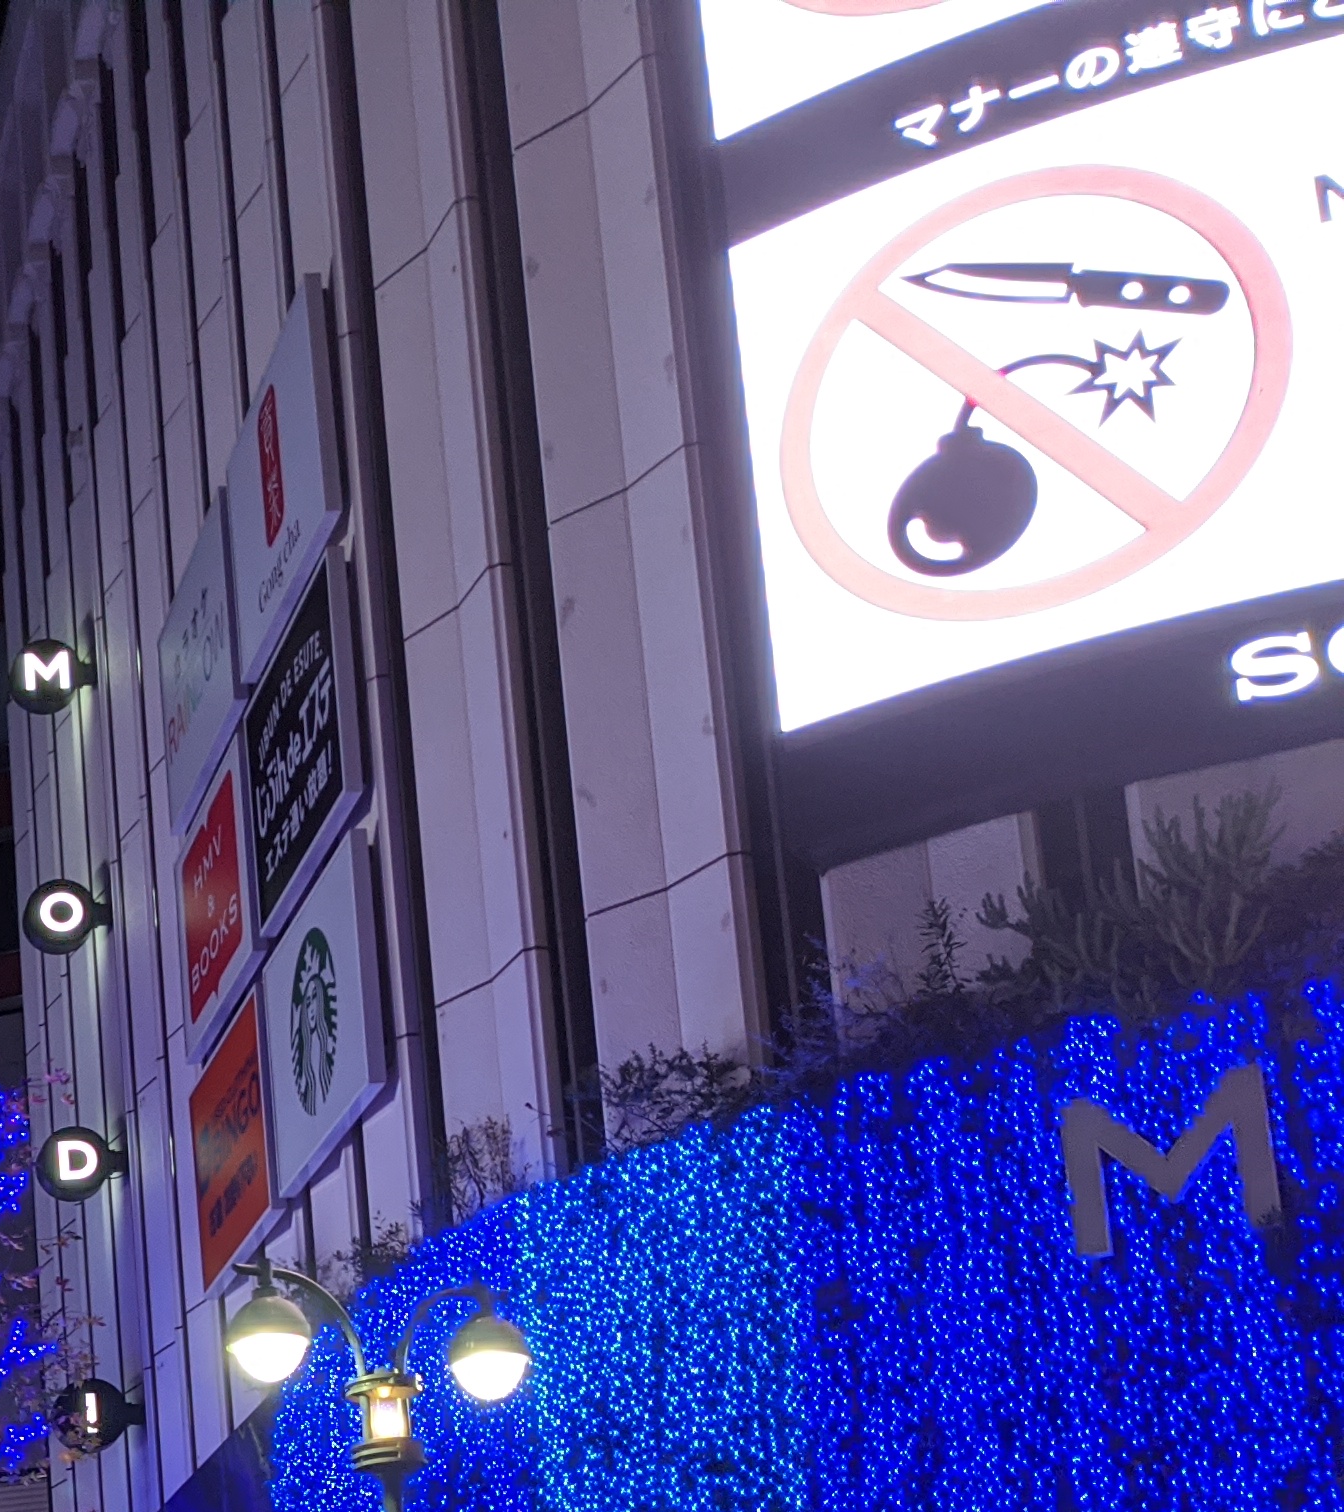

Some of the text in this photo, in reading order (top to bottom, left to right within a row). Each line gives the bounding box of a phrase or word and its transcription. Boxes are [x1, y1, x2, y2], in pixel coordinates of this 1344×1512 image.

[1231, 631, 1344, 701] S
[259, 696, 279, 770] JIBUN
[280, 669, 292, 703] DE
[194, 824, 221, 898] HMV
[192, 892, 237, 994] BOOKS
[207, 895, 215, 917] &
[1060, 1062, 1282, 1257] M
